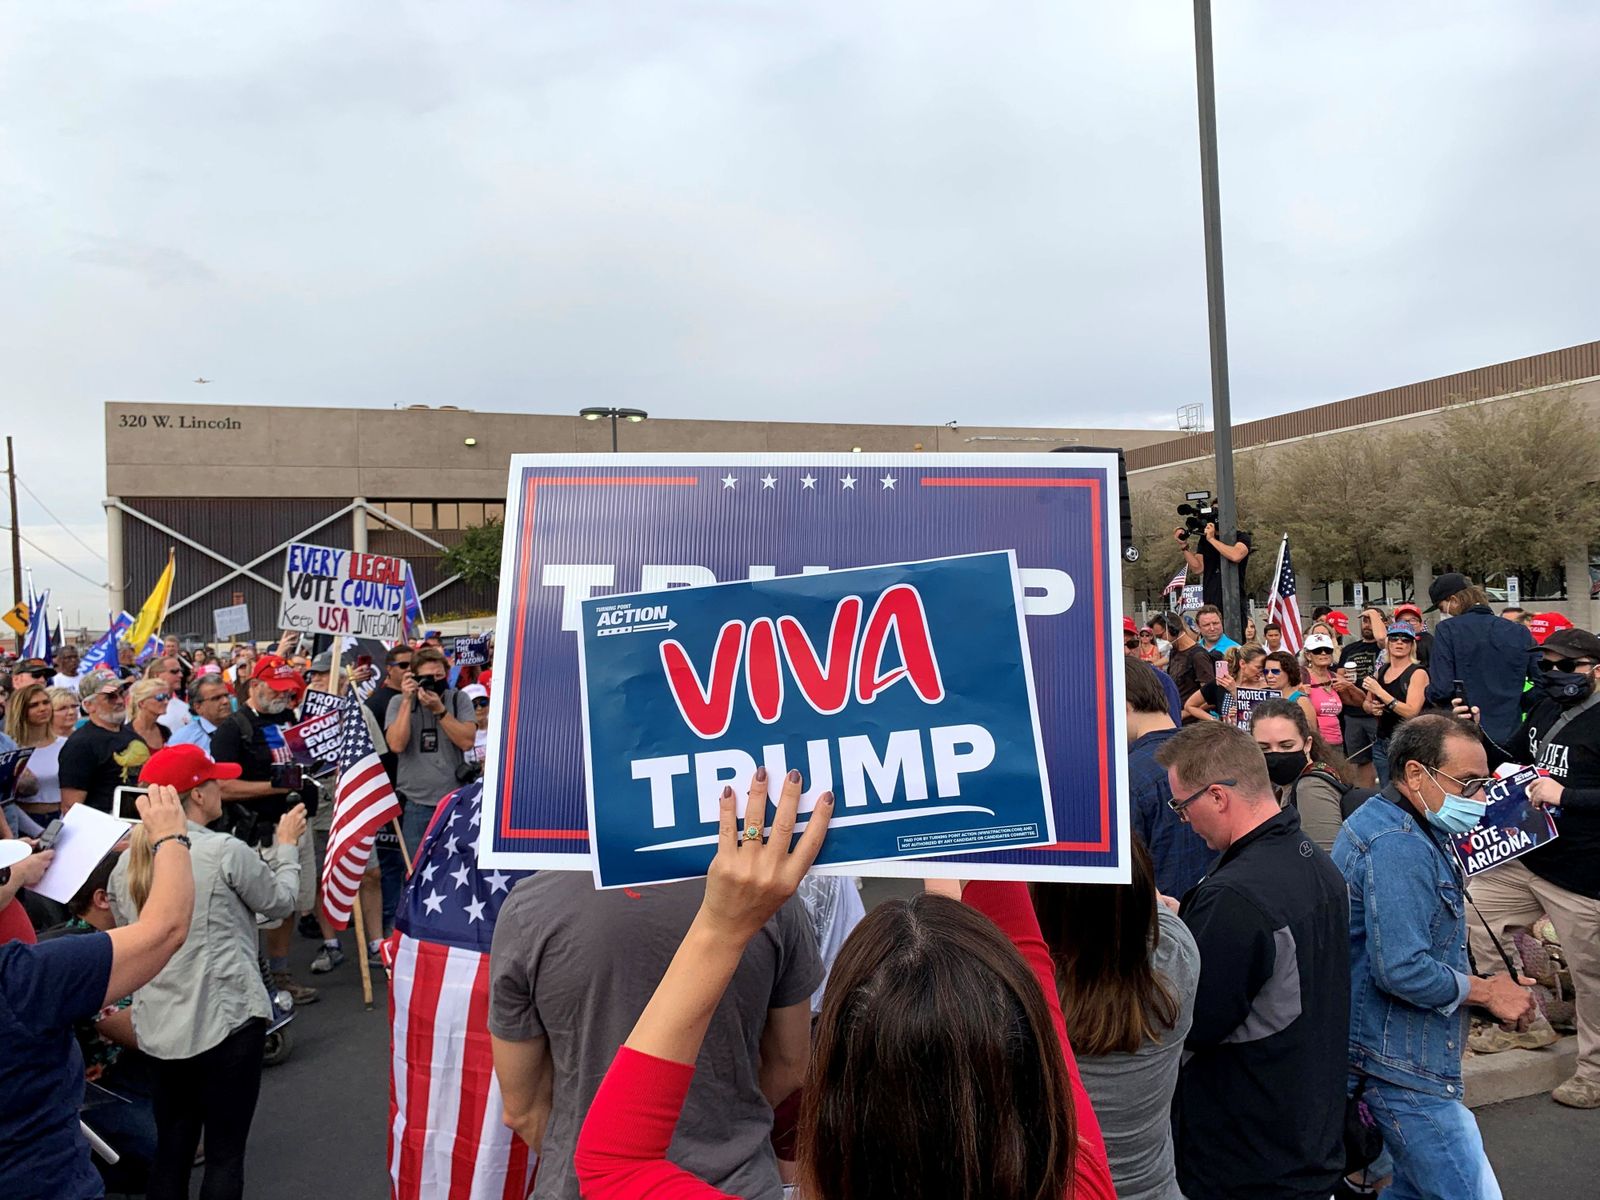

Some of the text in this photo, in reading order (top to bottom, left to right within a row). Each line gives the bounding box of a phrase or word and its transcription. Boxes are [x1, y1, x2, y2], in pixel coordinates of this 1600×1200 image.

[119, 414, 242, 430] 320 W. Lincoln
[290, 545, 406, 587] EVERY LEGAL
[287, 571, 403, 611] VOTE COUNTS
[281, 602, 313, 632] Keep
[318, 606, 349, 633] USA
[596, 605, 617, 613] TURNING
[596, 605, 668, 627] ACTION
[456, 656, 485, 666] ARIZONA
[659, 583, 946, 739] VIVA
[1237, 690, 1267, 701] PROTECT
[1237, 700, 1251, 710] THE
[305, 702, 328, 716] THE
[630, 724, 997, 829] TRUMP
[911, 840, 938, 848] AUTHORIZED
[1468, 830, 1532, 873] ARIZONA
